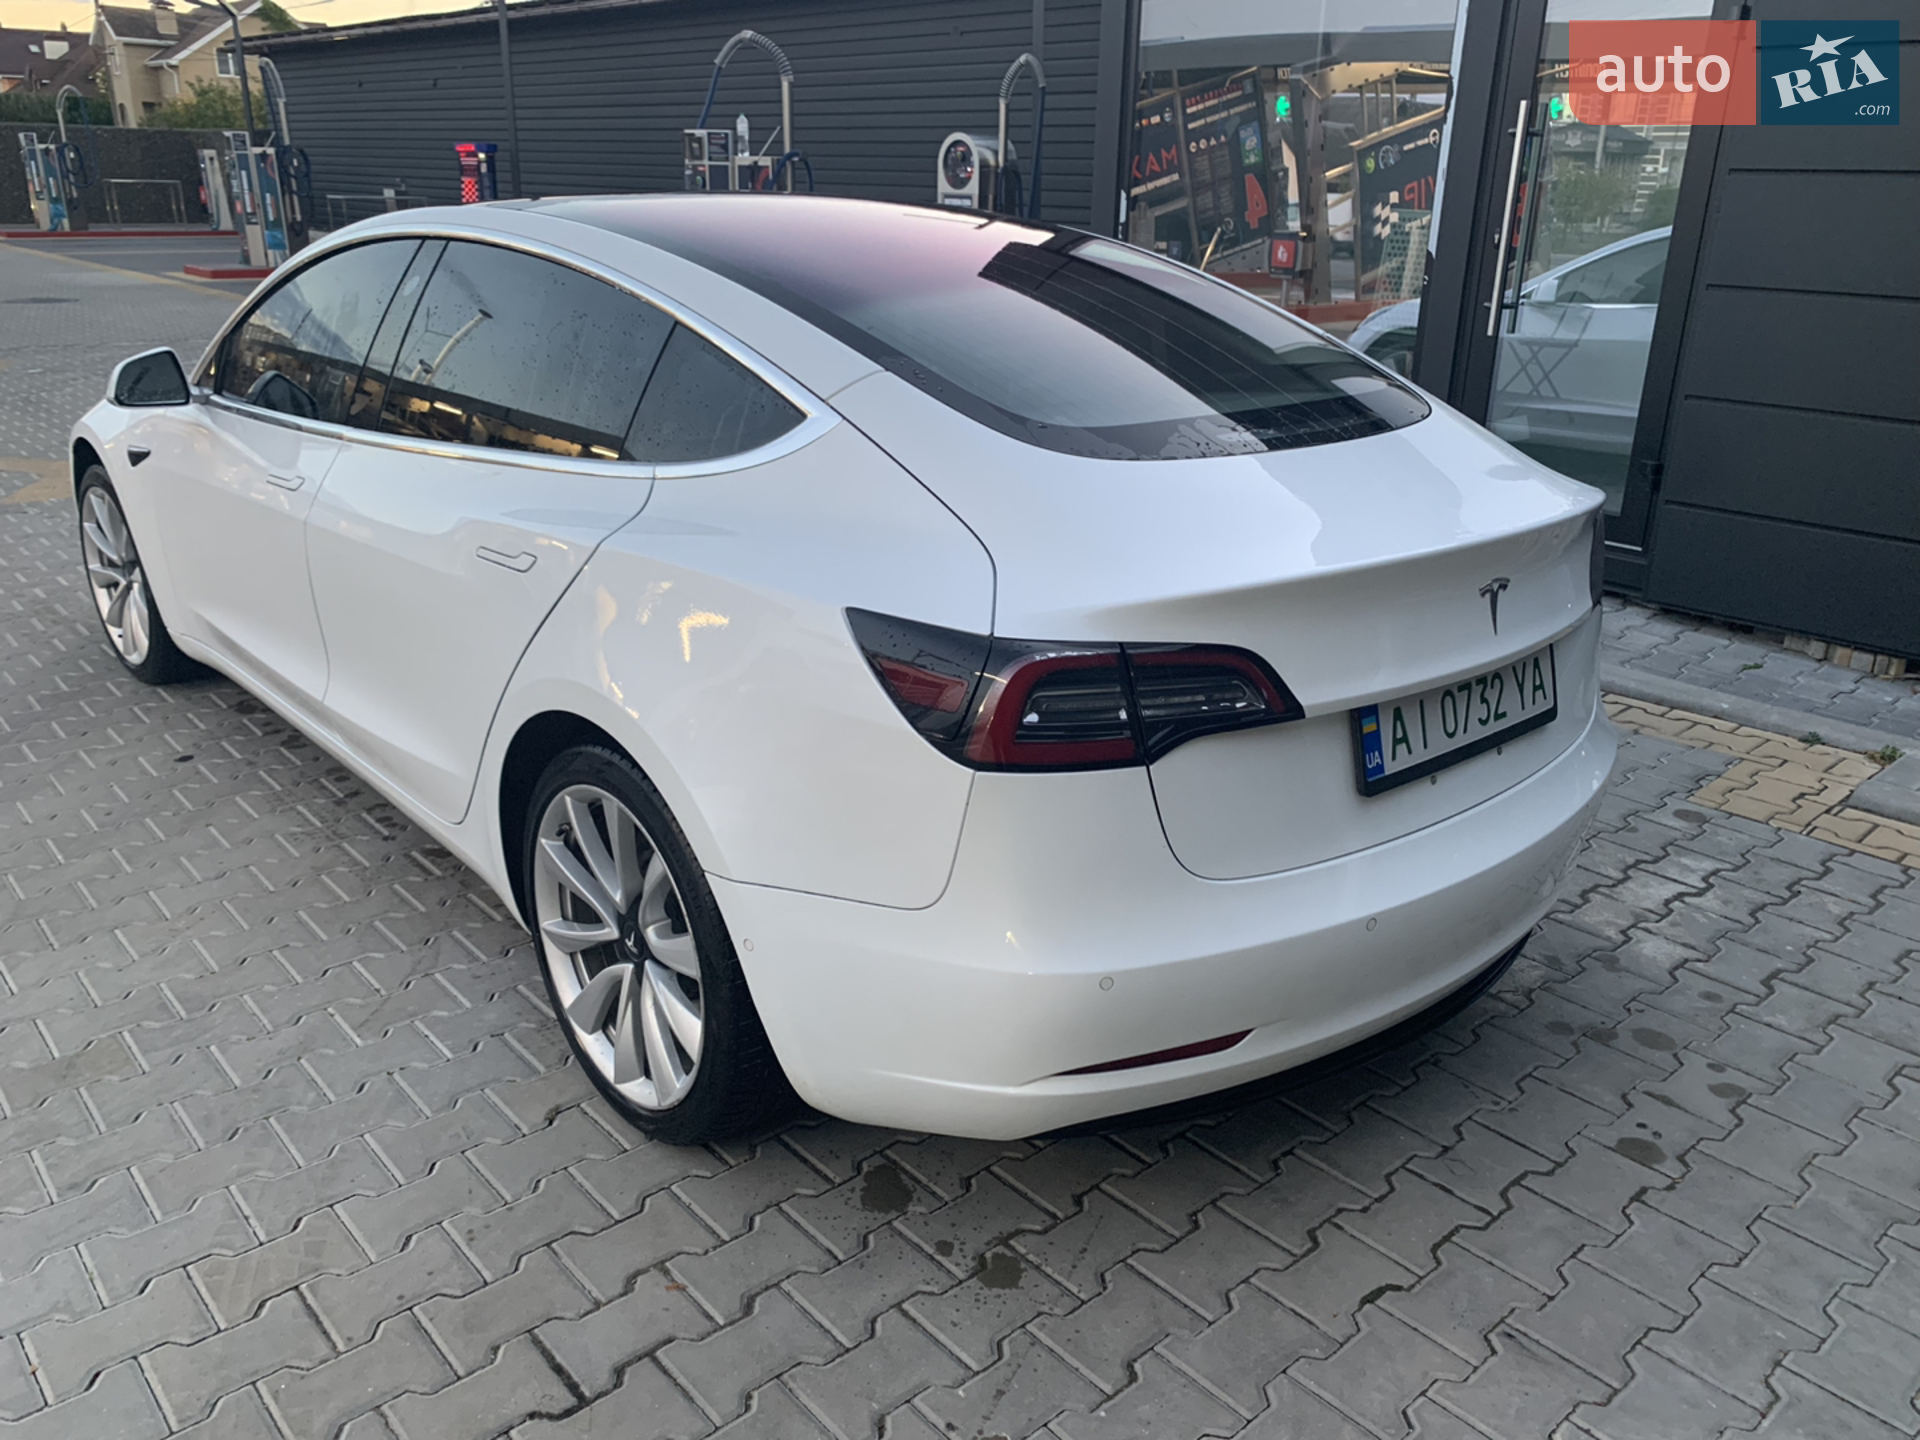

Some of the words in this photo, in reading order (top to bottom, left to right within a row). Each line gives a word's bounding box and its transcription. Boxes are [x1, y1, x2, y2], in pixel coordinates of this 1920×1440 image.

[1391, 699, 1428, 762] AI
[1440, 673, 1507, 739] 0732
[1512, 657, 1547, 711] YA
[1366, 751, 1382, 769] UA
